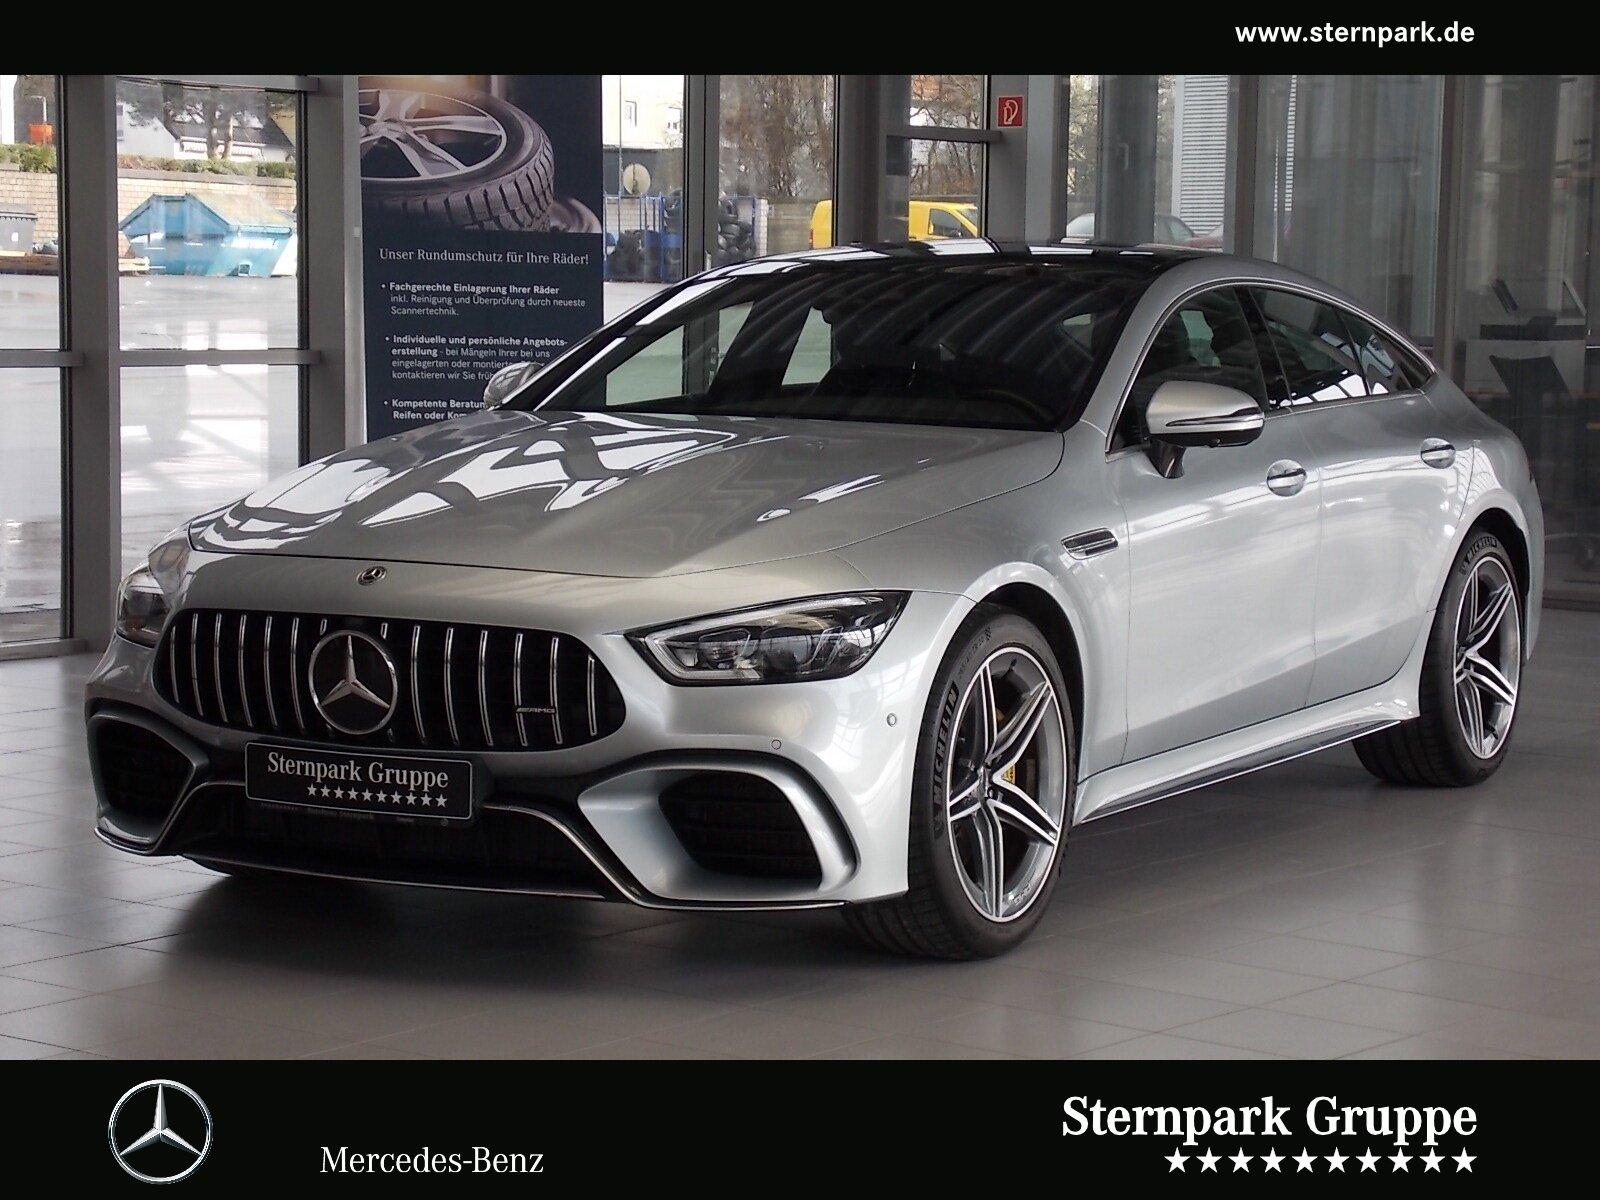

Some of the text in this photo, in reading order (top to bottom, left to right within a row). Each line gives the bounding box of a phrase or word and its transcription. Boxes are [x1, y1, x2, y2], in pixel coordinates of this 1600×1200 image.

[380, 248, 589, 265] Unser Rundumschutz für Ihre Räder!
[389, 281, 560, 295] Fachgerechte Einlagerung Ihrer Räder
[390, 294, 586, 308] inkl. Reinigung und Überprüfung durch neueste
[390, 306, 459, 316] Scannertechnik.
[393, 334, 568, 348] Individuelle und persönliche Angebots-
[391, 347, 438, 357] erstellung
[445, 347, 459, 356] bei
[460, 347, 497, 359] Mängeln
[498, 348, 518, 357] Ihrer
[520, 348, 533, 357] bei
[535, 350, 550, 358] uns
[391, 359, 449, 369] eingelagerten
[451, 360, 471, 368] oder
[392, 371, 494, 380] kontaktieren wir Sie früh
[392, 399, 486, 409] Kompetente Beratun
[393, 410, 422, 419] Reifen
[424, 411, 445, 420] oder
[933, 681, 960, 811] MICHELIN
[267, 751, 449, 792] Sternpark Gruppe
